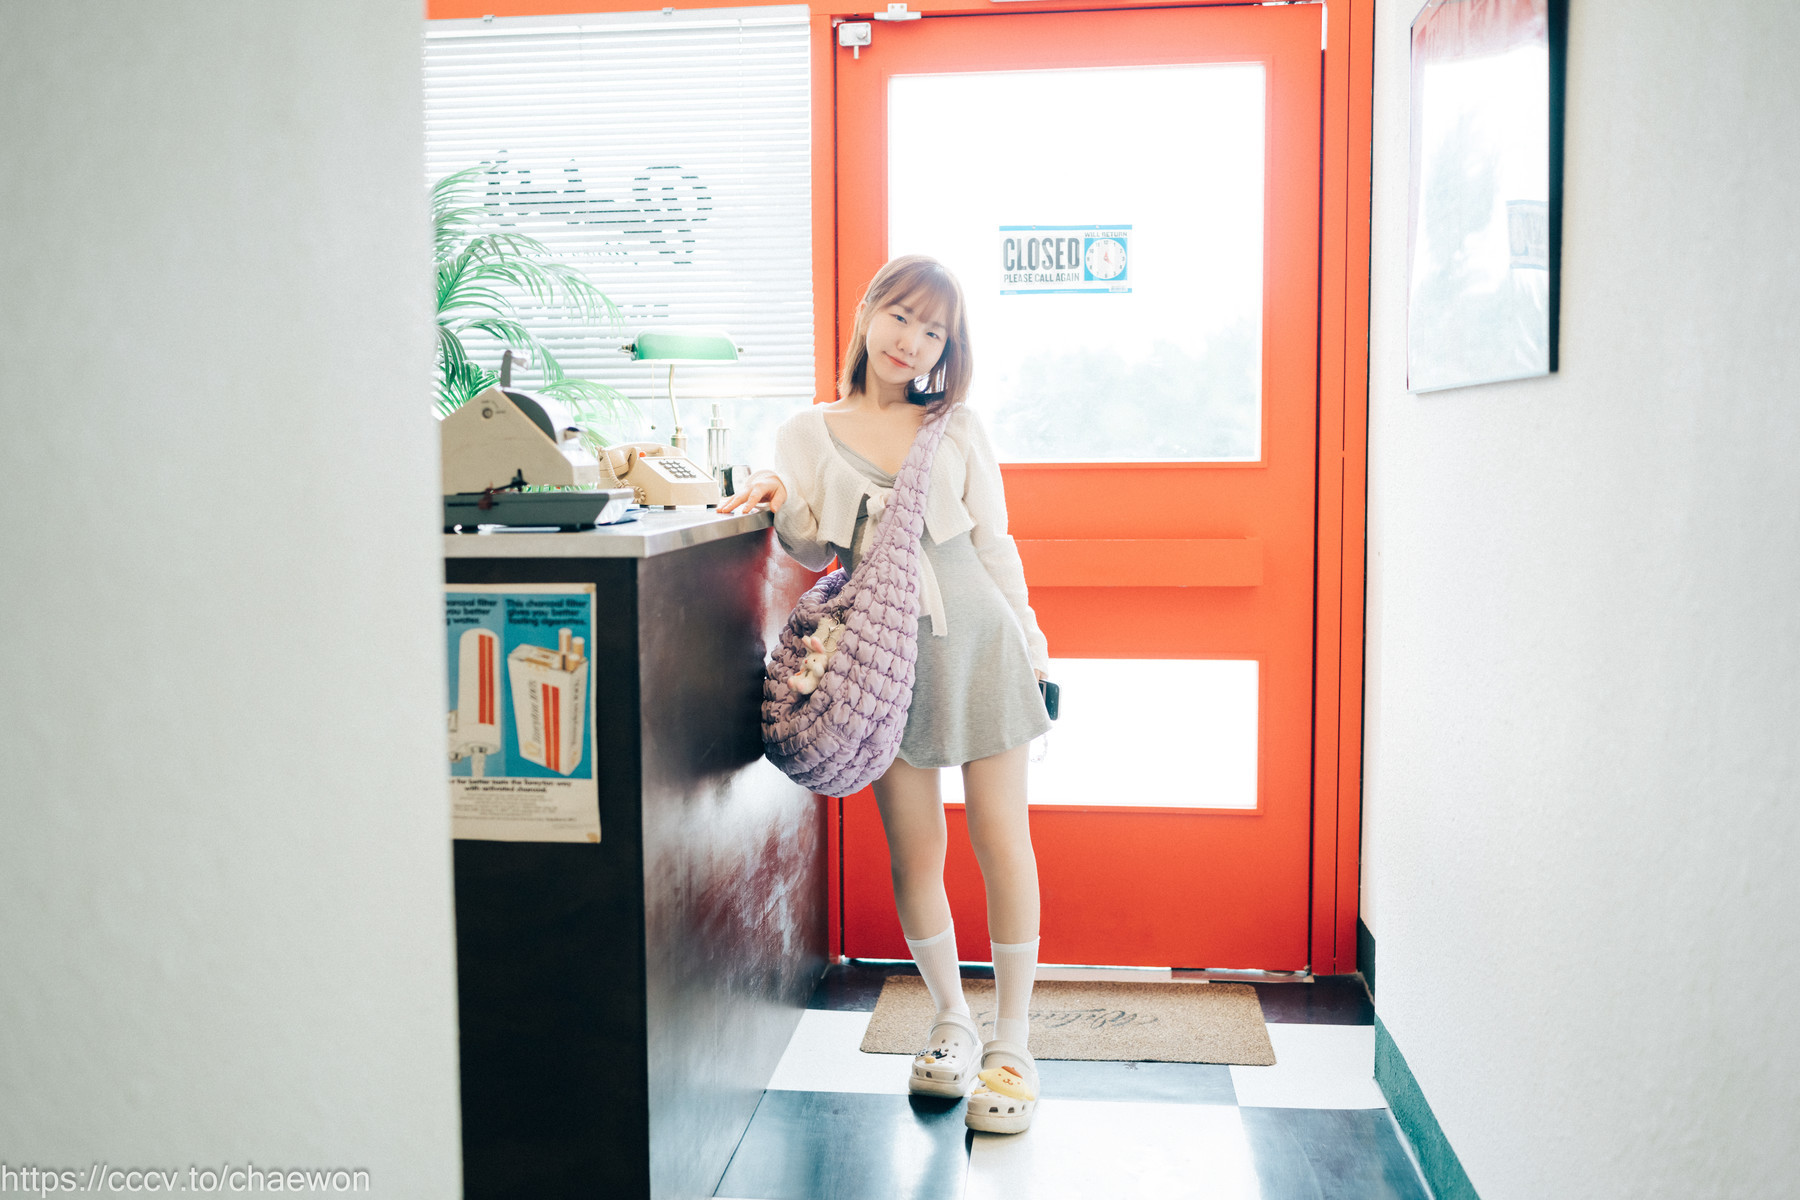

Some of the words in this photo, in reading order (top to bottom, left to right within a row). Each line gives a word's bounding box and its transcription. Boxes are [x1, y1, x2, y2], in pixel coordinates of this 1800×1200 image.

[1003, 237, 1080, 271] CLOSED
[1003, 273, 1033, 283] PLEASE
[1034, 273, 1054, 282] CALL
[1055, 272, 1080, 282] AGAIN
